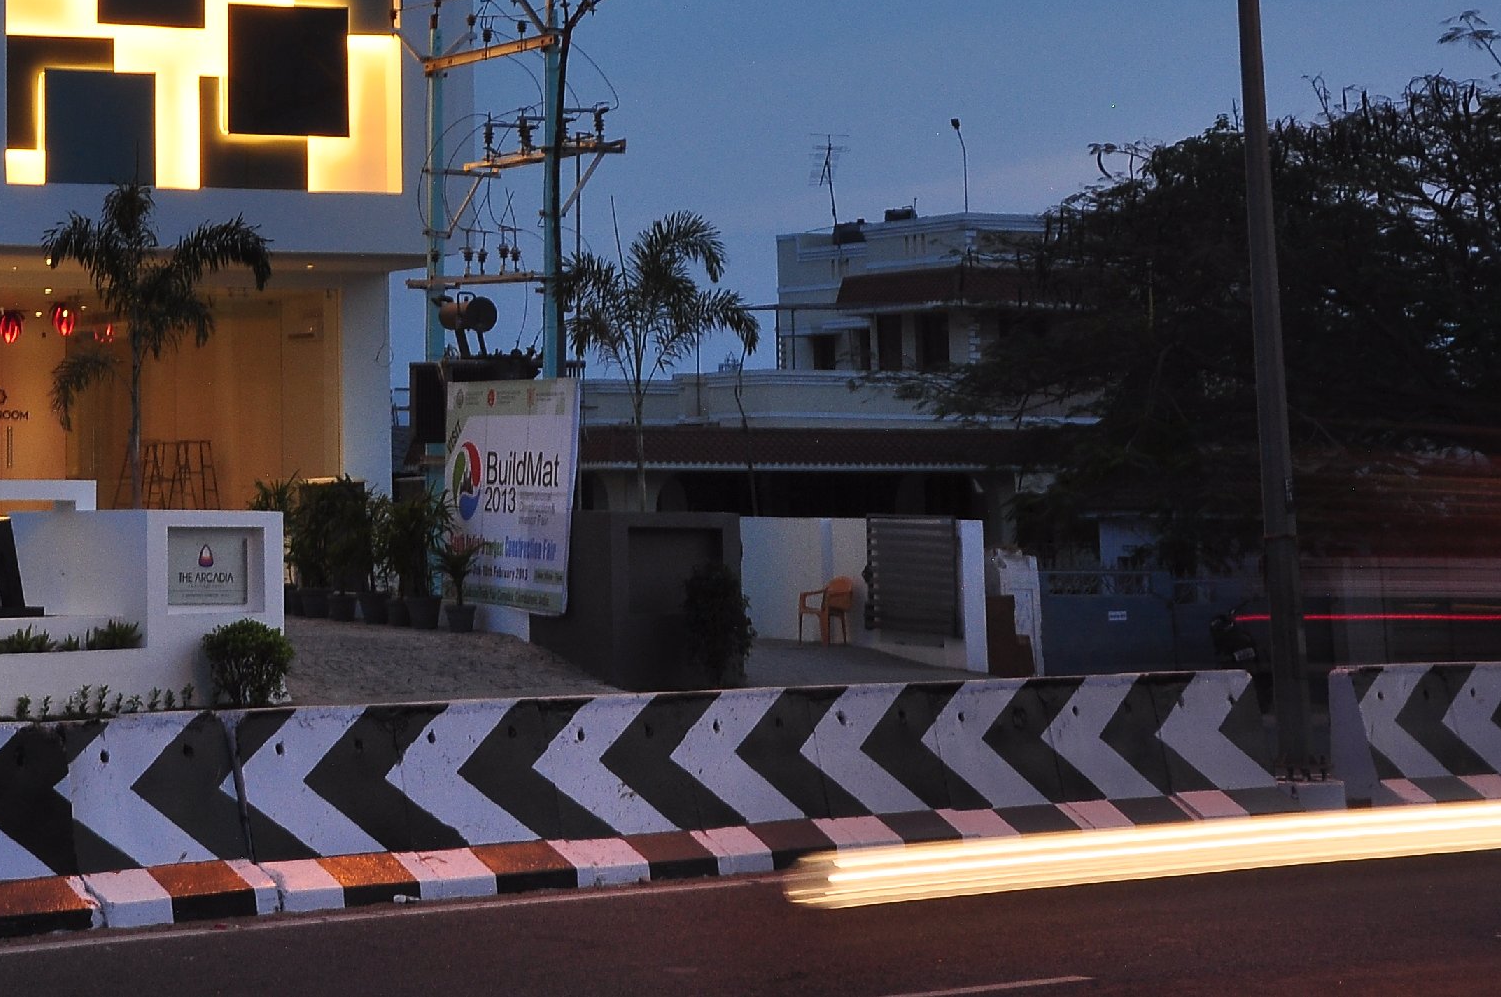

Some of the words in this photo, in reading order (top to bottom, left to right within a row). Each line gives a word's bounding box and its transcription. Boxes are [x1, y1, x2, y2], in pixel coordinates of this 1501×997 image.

[486, 450, 560, 488] BuildMat
[484, 486, 517, 514] 2013
[178, 572, 193, 583] THE
[195, 572, 234, 583] ARCADIA
